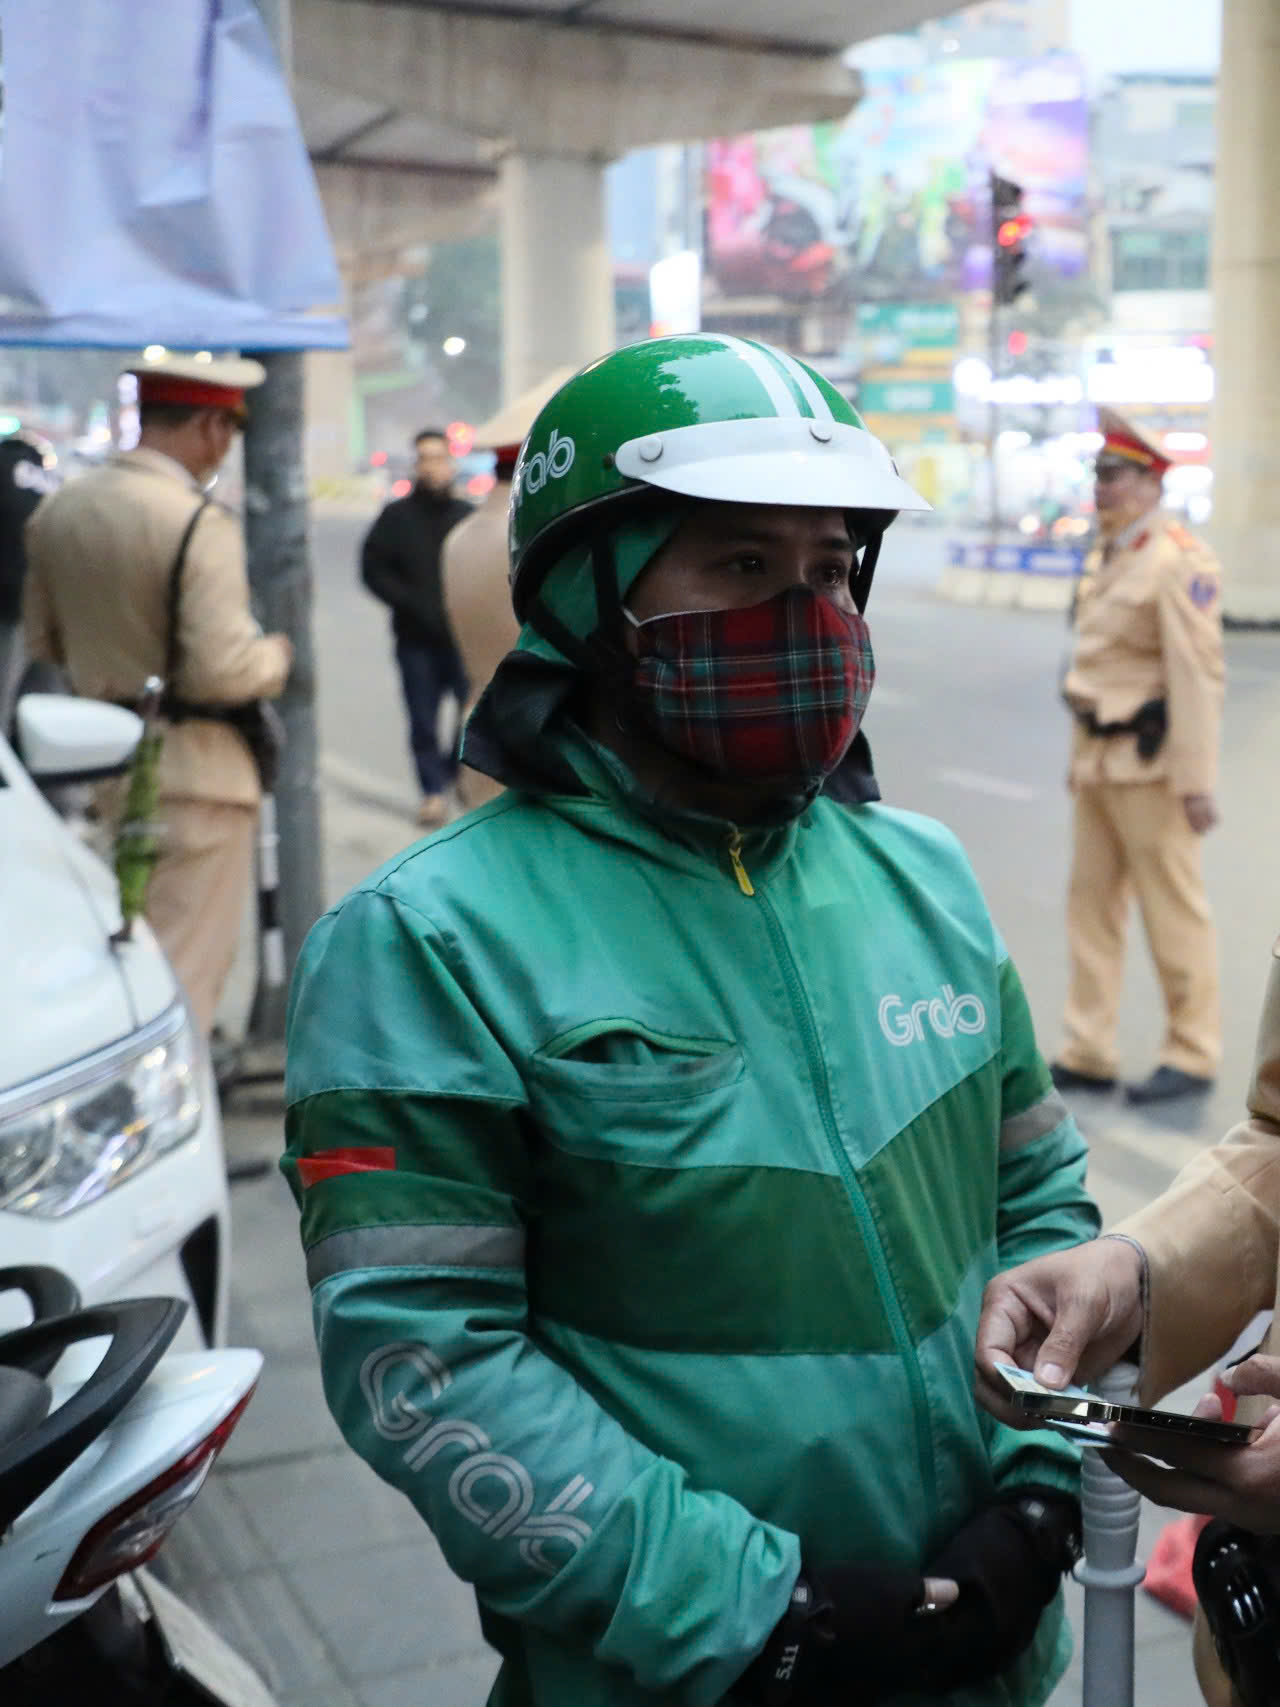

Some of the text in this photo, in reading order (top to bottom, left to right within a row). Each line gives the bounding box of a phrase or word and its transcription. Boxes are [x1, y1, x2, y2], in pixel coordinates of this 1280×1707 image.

[515, 429, 576, 507] rab
[878, 983, 986, 1047] Grab
[359, 1340, 594, 1576] Grab
